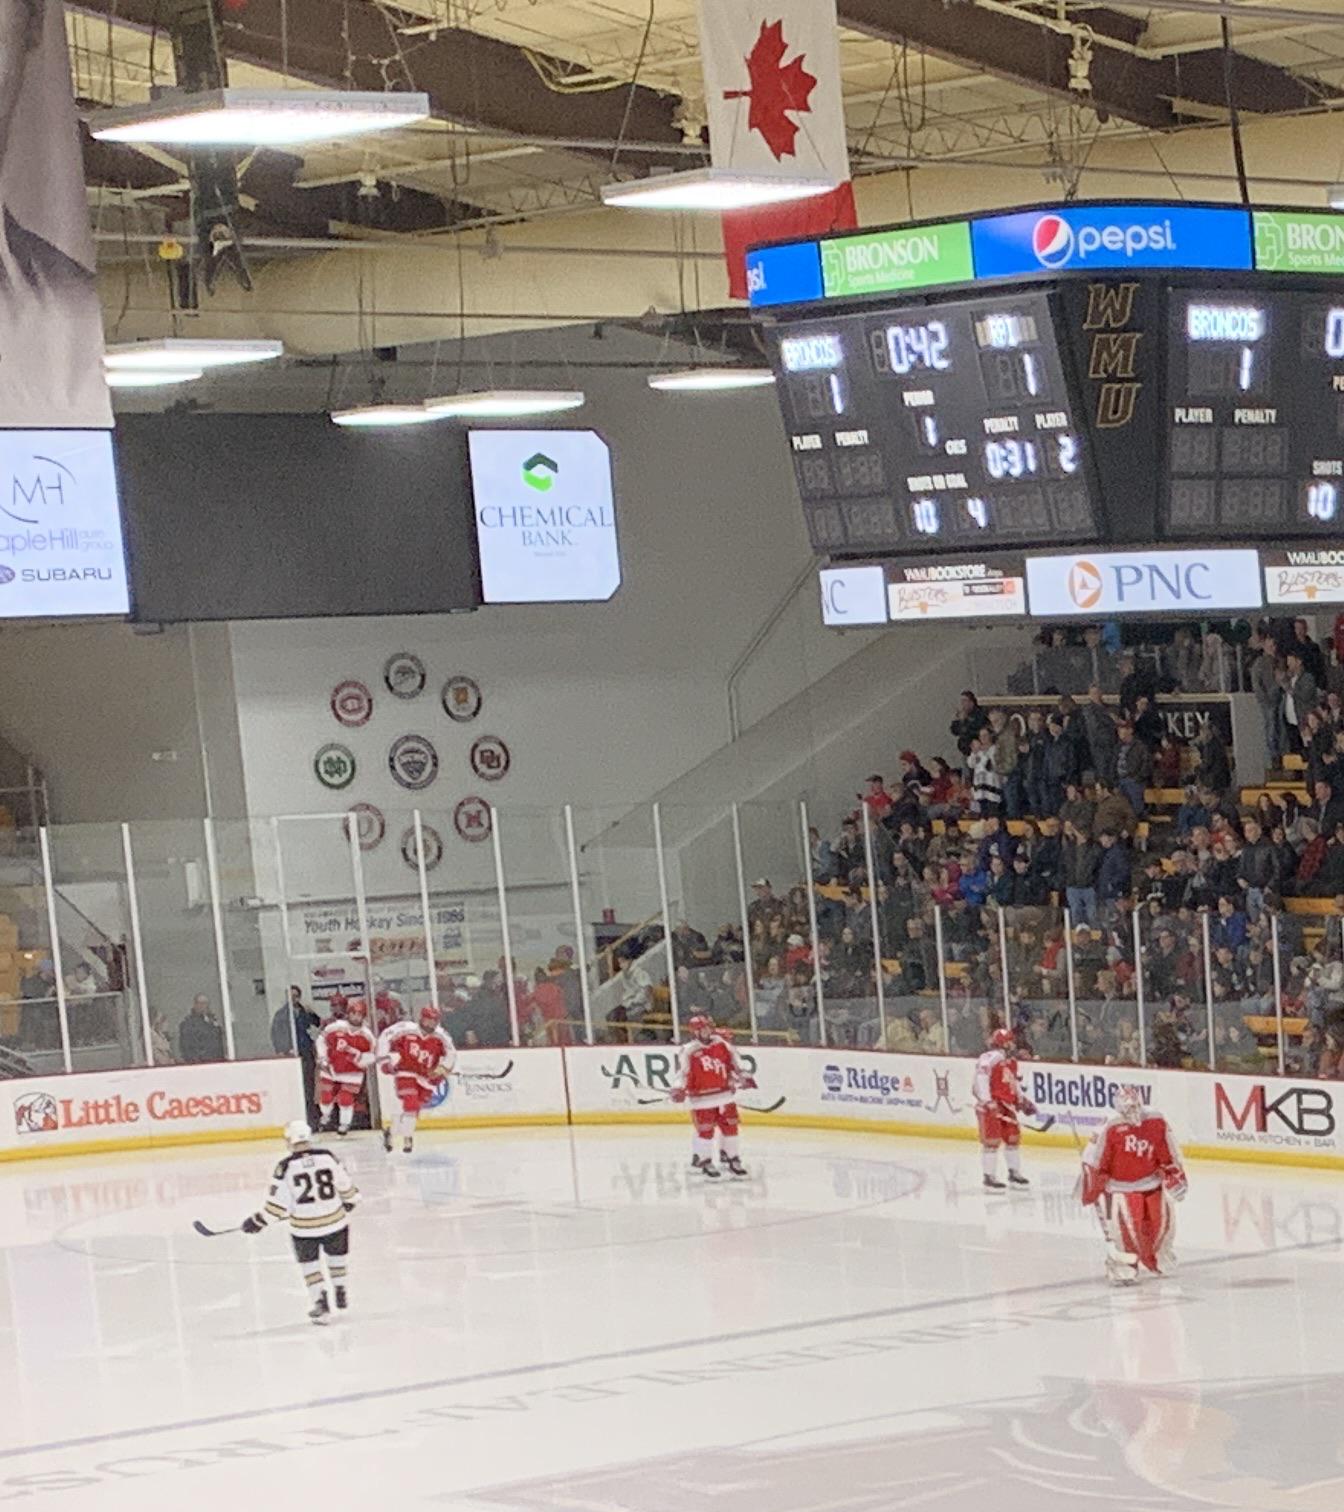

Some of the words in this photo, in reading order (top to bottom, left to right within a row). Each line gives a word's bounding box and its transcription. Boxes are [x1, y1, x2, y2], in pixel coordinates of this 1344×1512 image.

[845, 235, 939, 272] BRONSON
[1078, 220, 1175, 259] pepsi
[1288, 252, 1323, 267] Sports
[1188, 304, 1265, 341] BRONCOS
[887, 320, 949, 374] 0:42
[1174, 407, 1213, 423] PLAYER
[1234, 409, 1276, 424] PENALTY
[480, 506, 615, 528] CHEMICAL
[913, 499, 939, 533] 10
[1307, 481, 1336, 521] 10
[522, 530, 574, 546] BANK
[21, 567, 112, 582] SUBARU
[1111, 562, 1212, 602] PNC
[344, 914, 393, 932] Hokey
[397, 912, 424, 927] Sinc
[846, 1067, 900, 1096] Ridge
[1033, 1072, 1151, 1108] BlackBey
[60, 1095, 139, 1128] Little
[146, 1091, 262, 1120] Caesars
[1215, 1082, 1336, 1136] MKB
[1258, 1134, 1302, 1146] KITCHEN
[1315, 1137, 1336, 1148] BAR
[293, 1168, 335, 1204] 28
